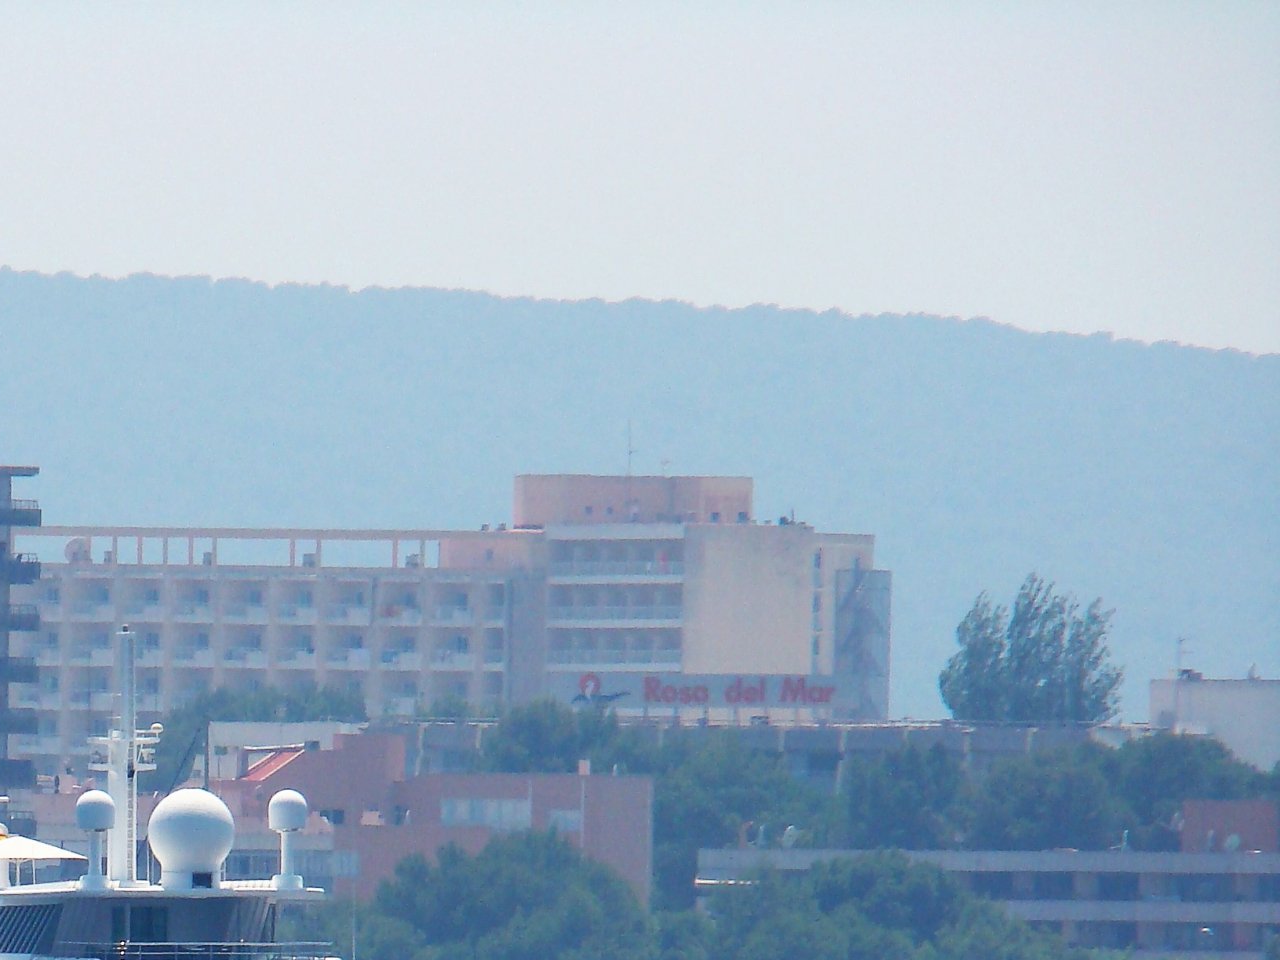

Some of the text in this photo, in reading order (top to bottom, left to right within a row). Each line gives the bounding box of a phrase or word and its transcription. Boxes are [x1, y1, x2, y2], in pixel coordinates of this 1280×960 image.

[644, 676, 836, 704] Rosa del Mar
